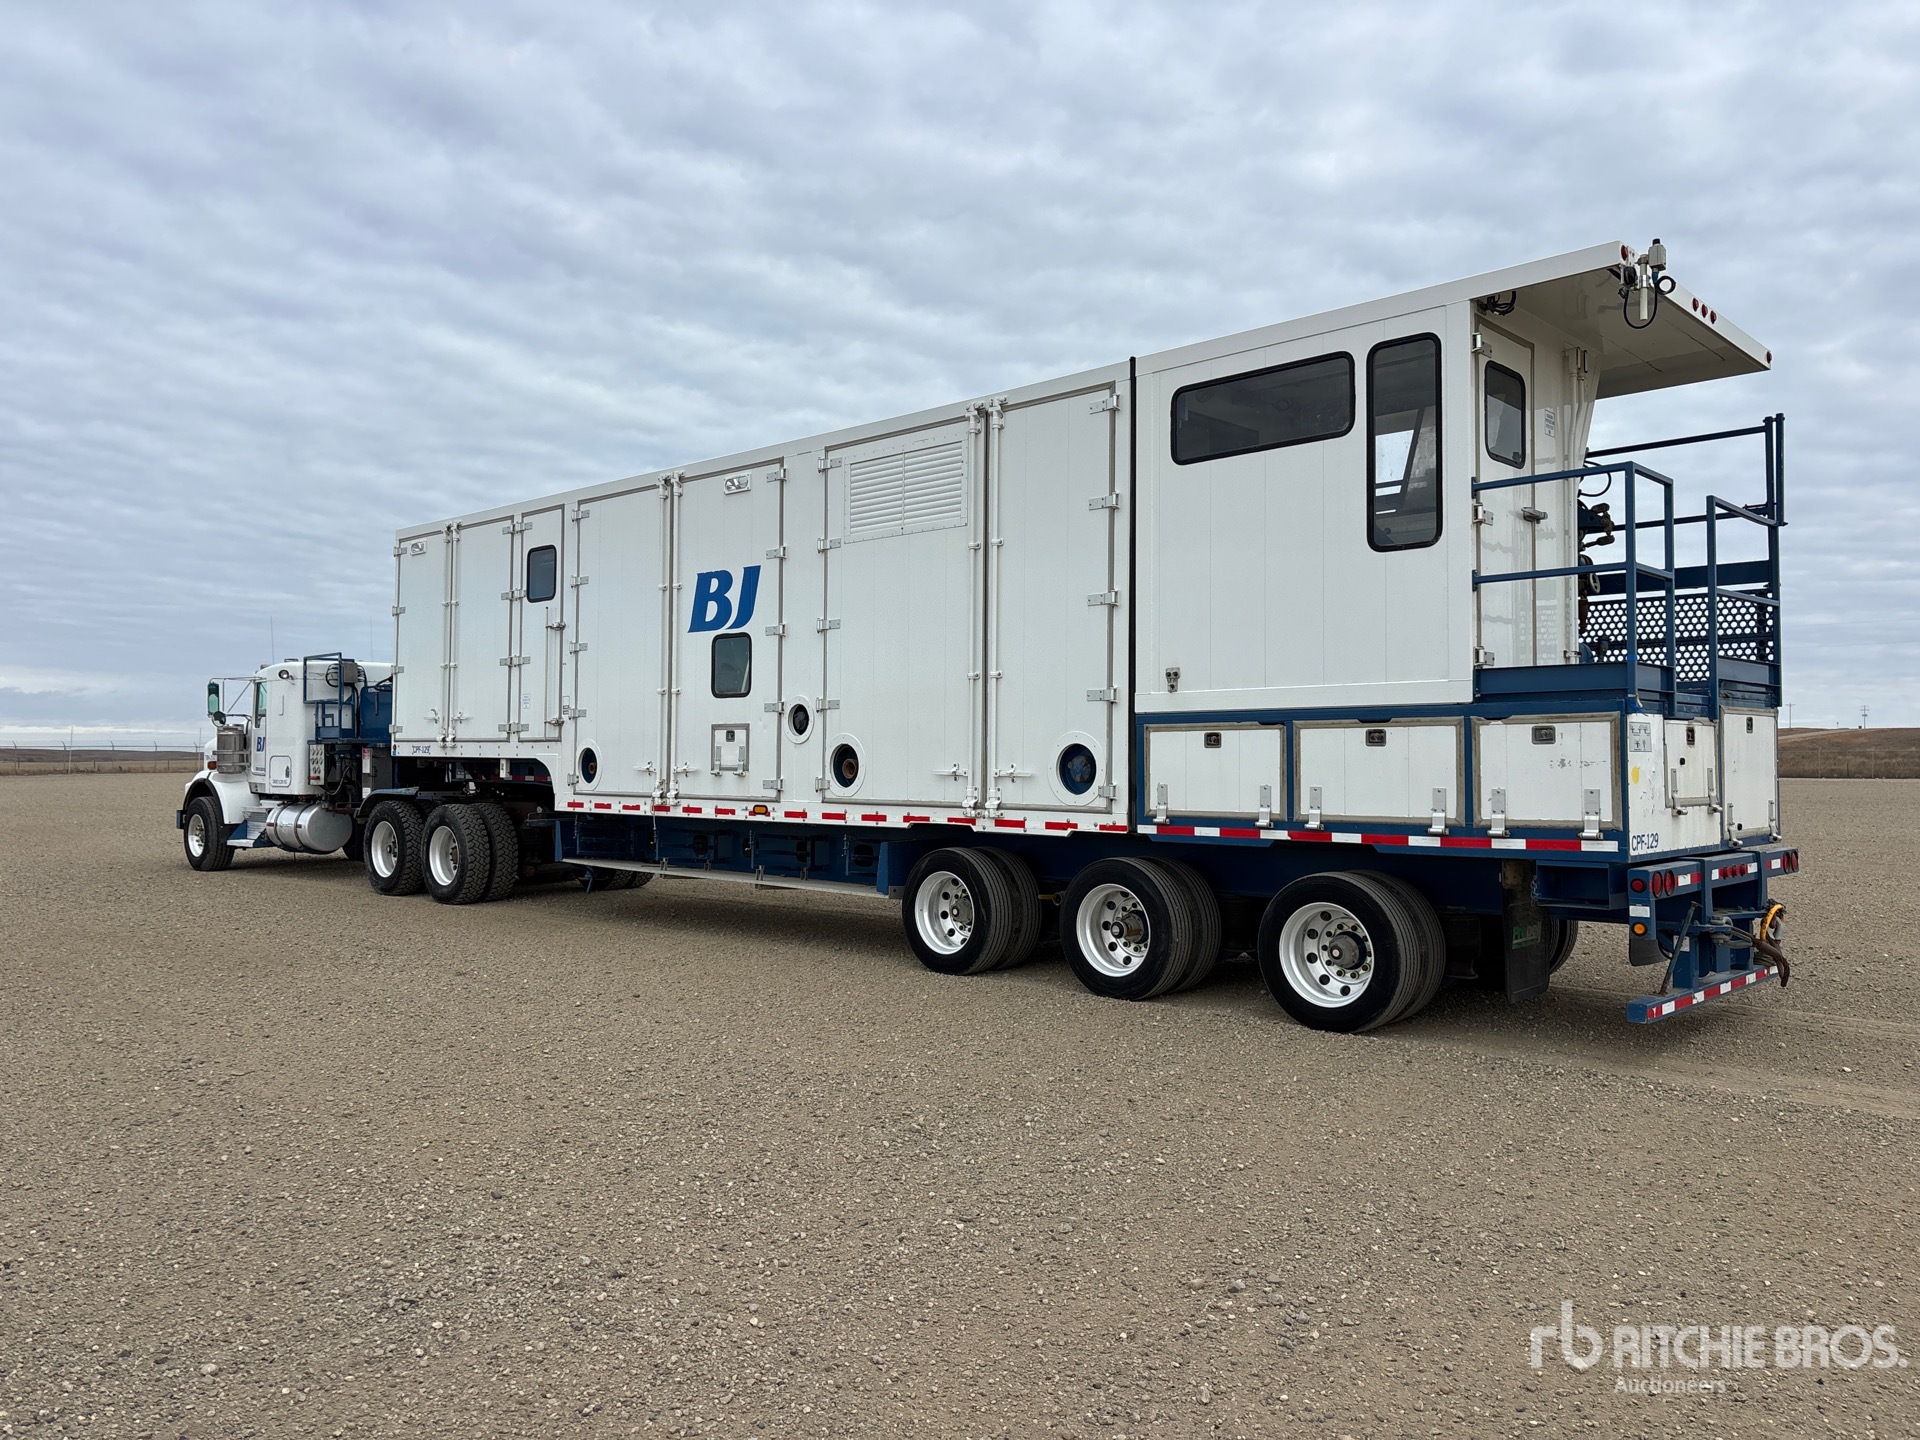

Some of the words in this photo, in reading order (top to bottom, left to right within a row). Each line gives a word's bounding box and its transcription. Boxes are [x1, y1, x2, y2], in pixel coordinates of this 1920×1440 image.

[687, 565, 761, 633] BJ
[256, 736, 266, 752] BJ
[1631, 832, 1659, 851] CPF-129
